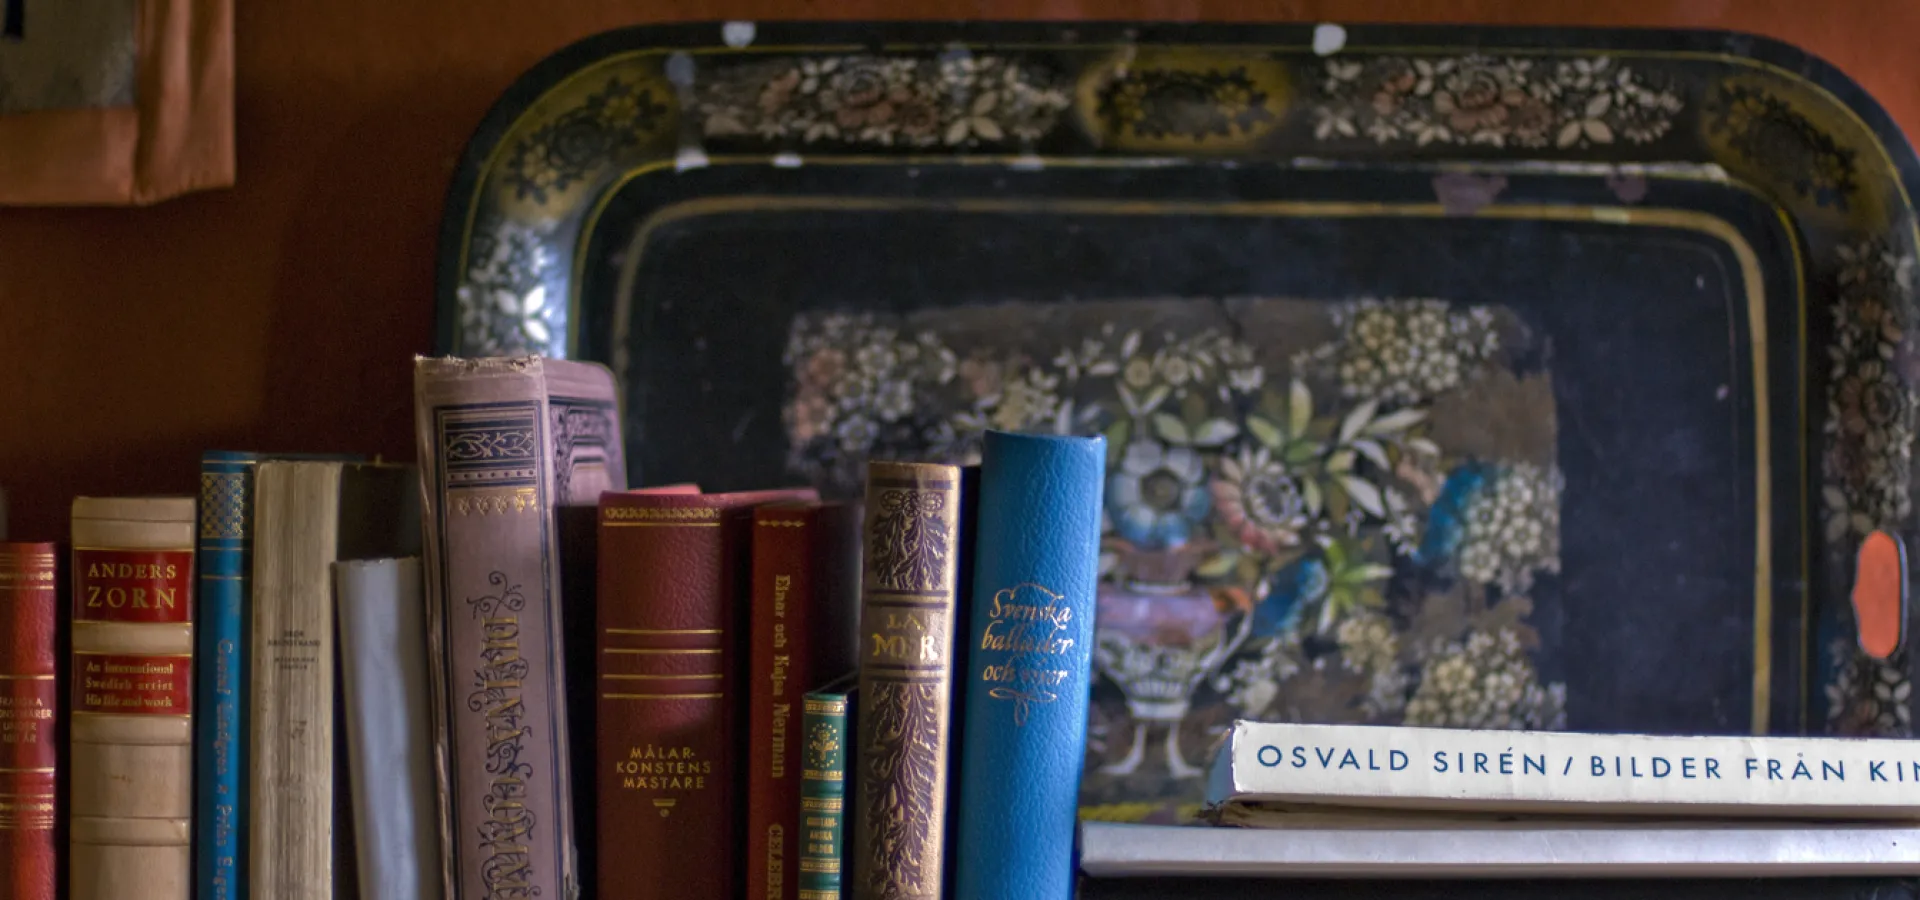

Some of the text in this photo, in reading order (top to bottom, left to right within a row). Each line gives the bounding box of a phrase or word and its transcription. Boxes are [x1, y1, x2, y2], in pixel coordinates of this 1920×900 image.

[87, 563, 177, 579] ANDERS
[87, 586, 177, 609] ZORN
[989, 582, 1072, 630] Svenska
[887, 612, 925, 631] LA
[981, 620, 1074, 655] ballader
[86, 660, 101, 672] An
[983, 655, 1015, 682] och
[85, 676, 173, 691] Swedish artist
[481, 615, 522, 748] DIVINA
[770, 574, 790, 778] Einar och Kajsa Nerman
[121, 694, 142, 706] and
[144, 696, 173, 707] work
[630, 744, 695, 759] MÅLAR-
[616, 761, 711, 774] KONSTENS
[1257, 745, 1409, 771] OSVALD
[1433, 747, 1547, 776] SIRÉN
[1590, 756, 1721, 779] BILDER
[1745, 752, 1845, 781] FRÅN
[623, 776, 704, 789] MÄSTARE
